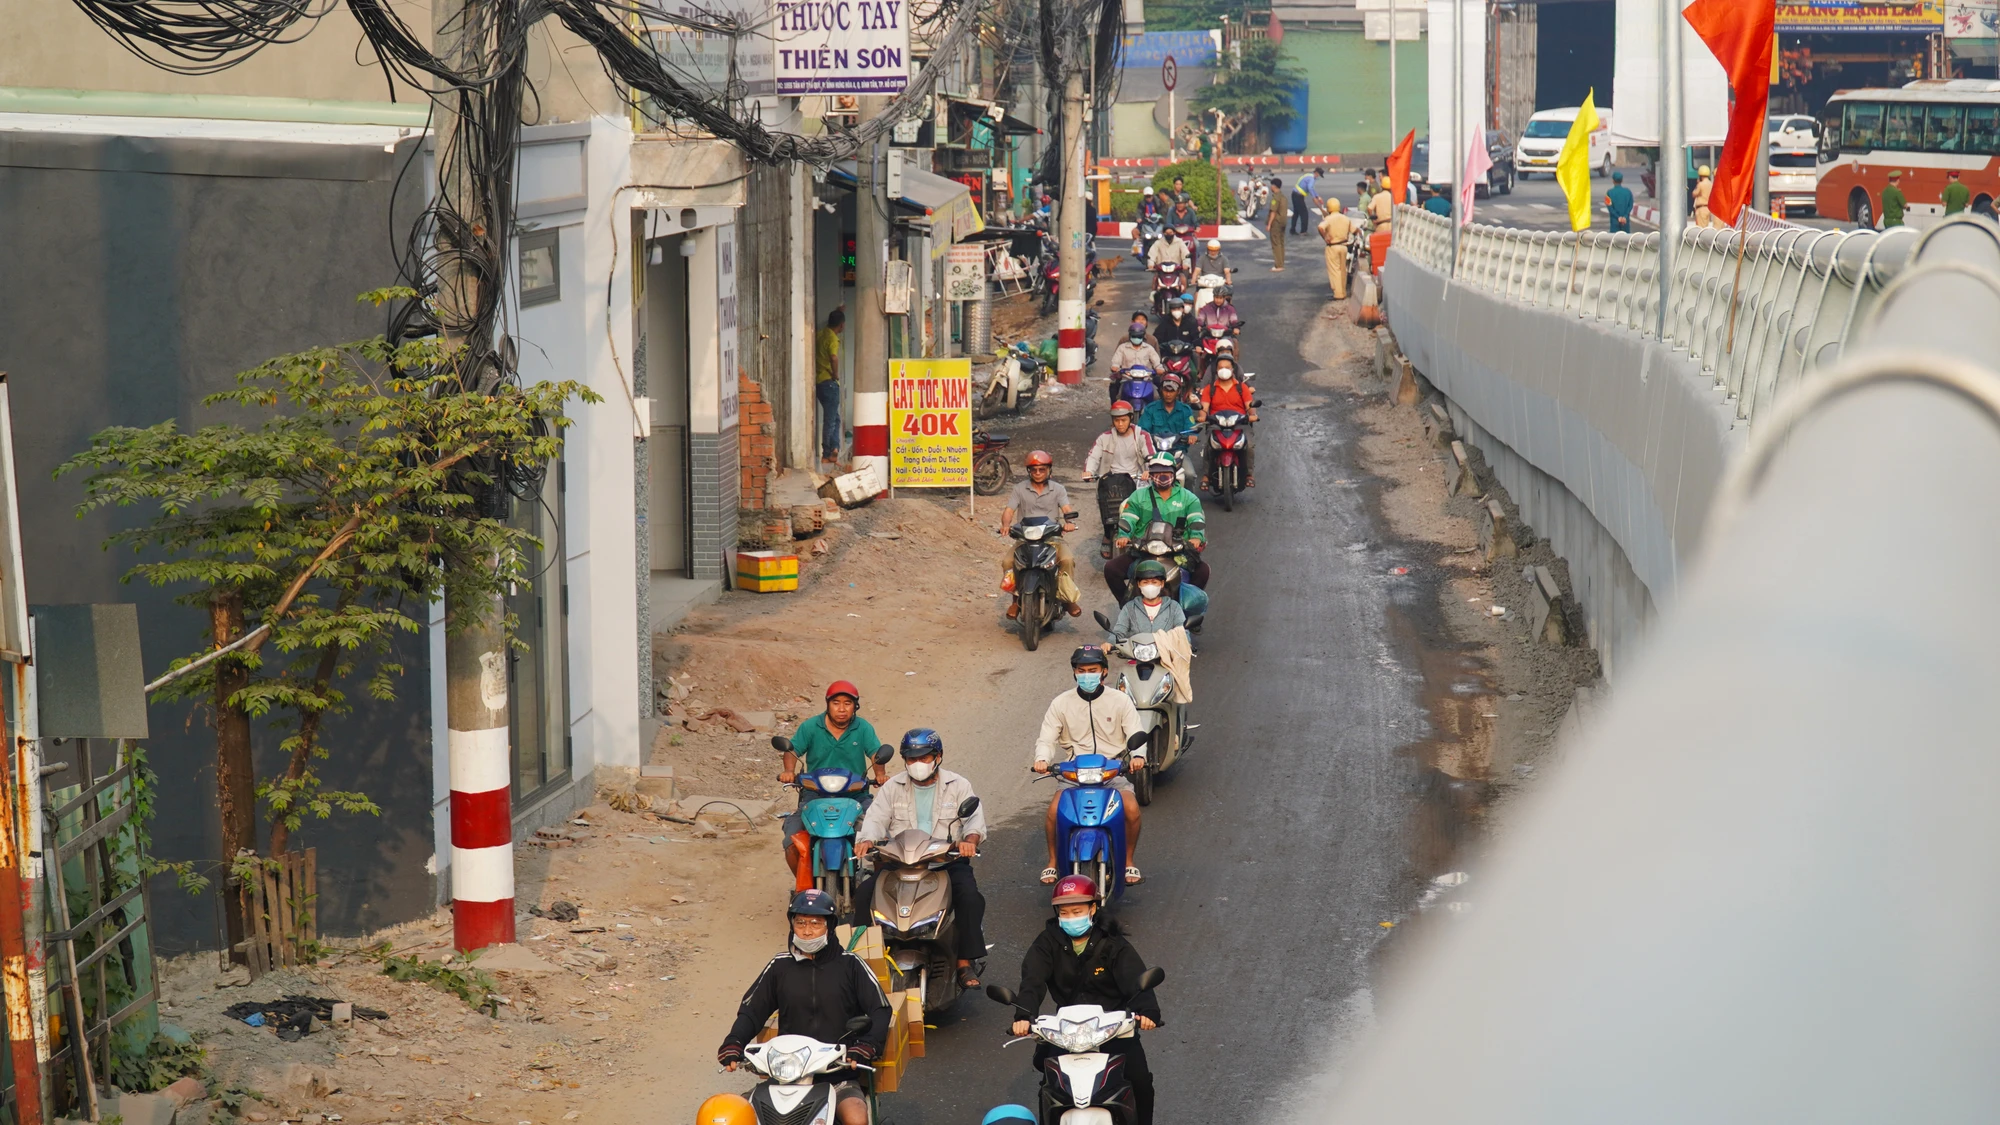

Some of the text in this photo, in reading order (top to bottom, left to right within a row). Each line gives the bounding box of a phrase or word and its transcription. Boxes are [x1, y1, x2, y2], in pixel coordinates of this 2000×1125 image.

[779, 44, 902, 69] THIÊN SƠN
[893, 363, 968, 408] CẮT TÓC NAM
[903, 413, 959, 436] 40K
[896, 445, 906, 453] Cắt
[947, 446, 968, 455] Nhuộm
[904, 456, 920, 465] Trang
[922, 454, 937, 463] Điểm
[949, 456, 960, 464] Tiệc
[912, 466, 922, 475] Gội
[925, 465, 936, 474] Đầu
[942, 467, 968, 475] Massage
